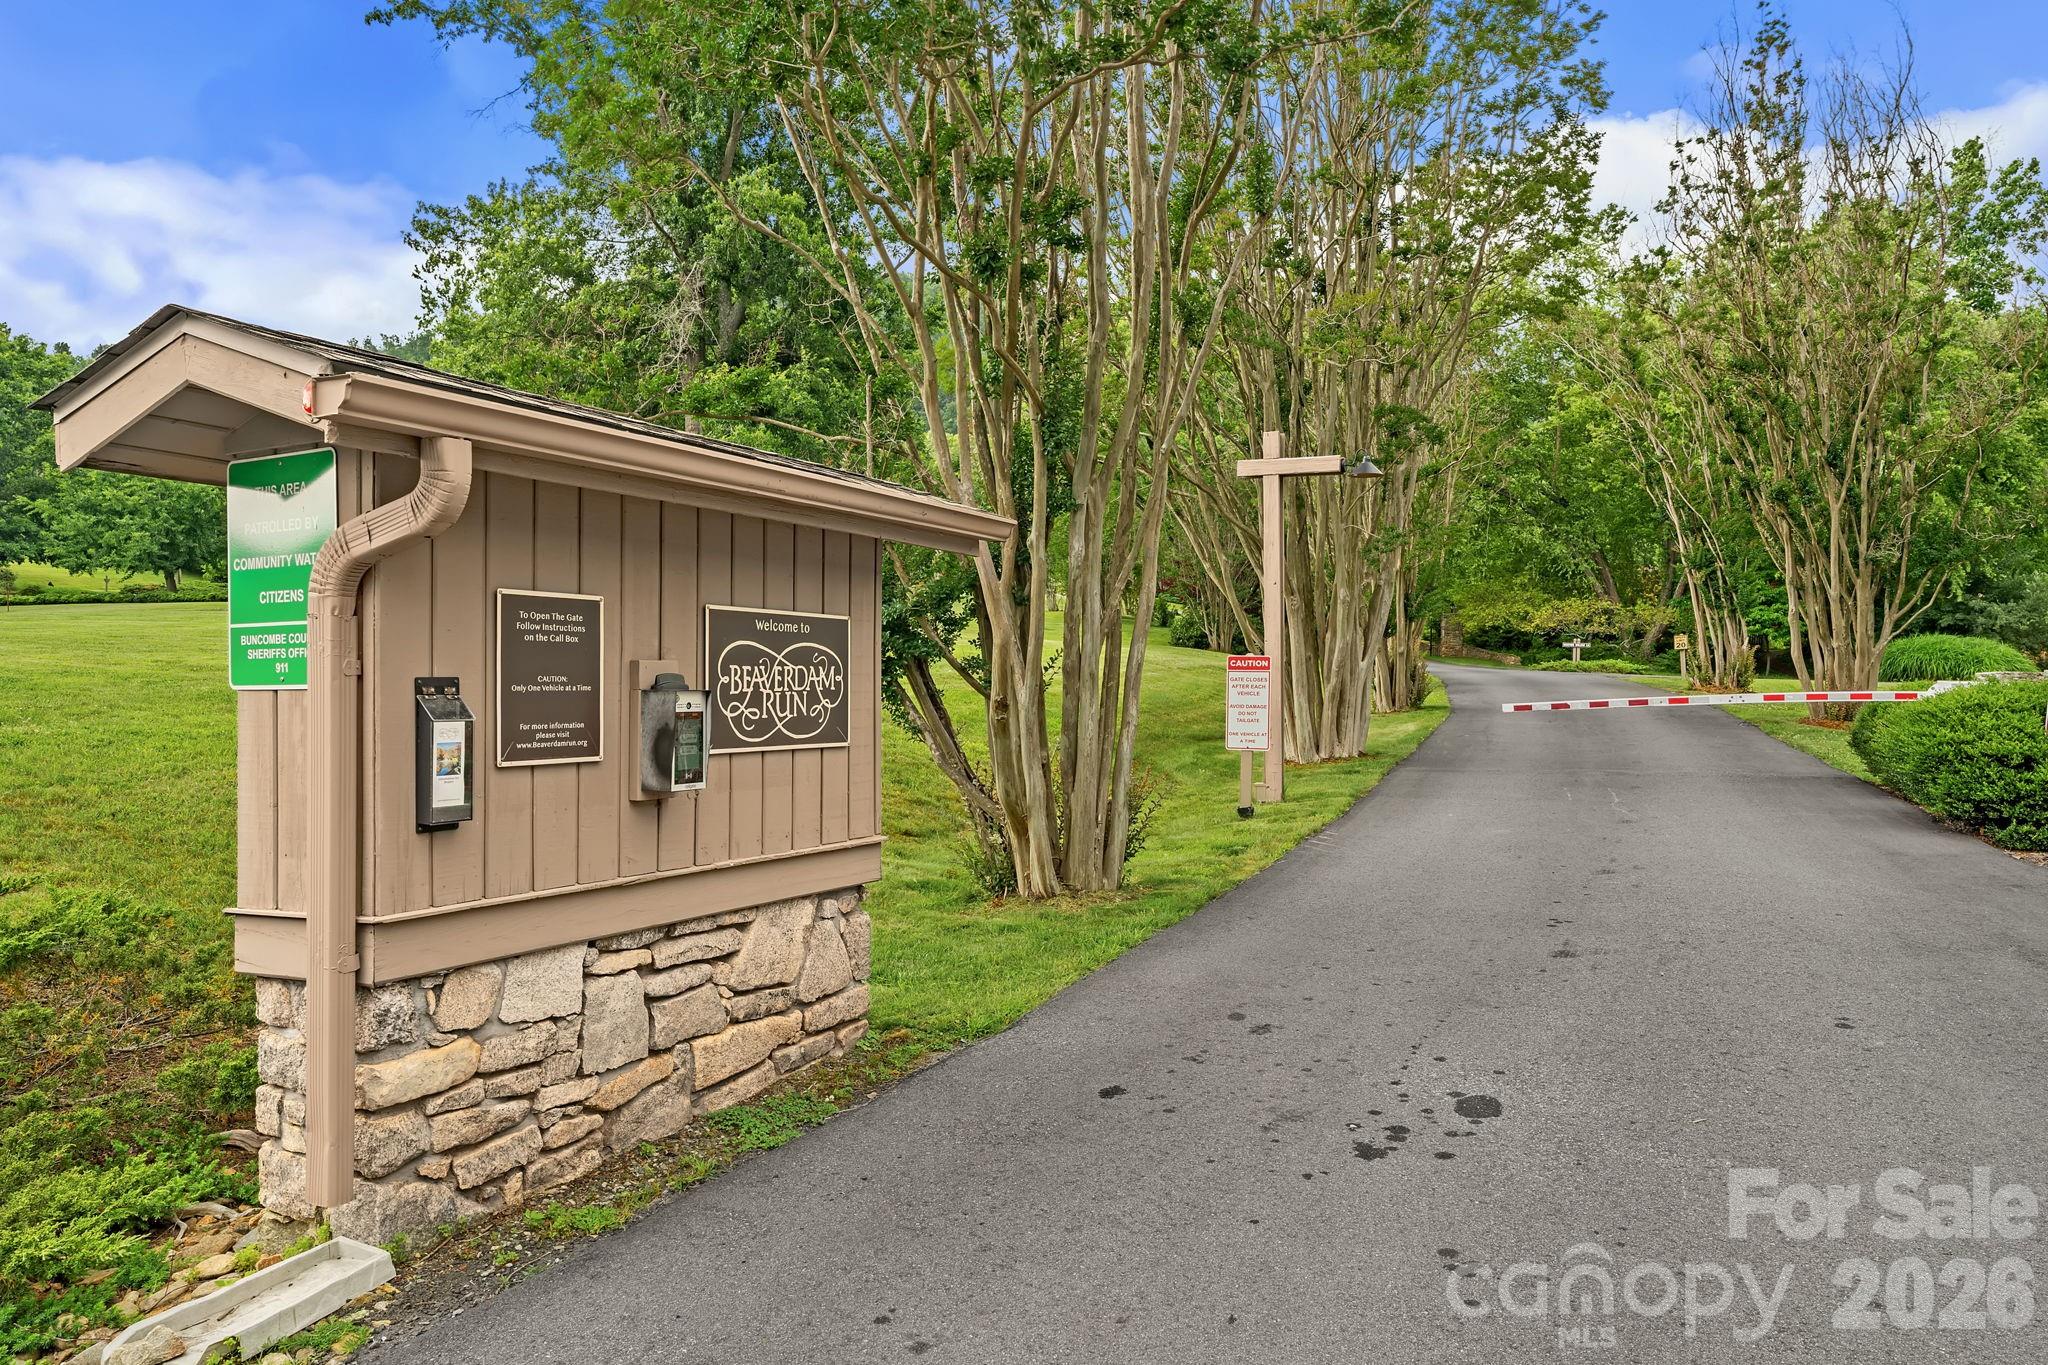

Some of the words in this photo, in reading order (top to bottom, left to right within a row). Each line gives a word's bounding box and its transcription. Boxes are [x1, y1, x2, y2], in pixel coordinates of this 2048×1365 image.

[280, 481, 307, 496] AREA
[244, 518, 302, 536] PATROLLED
[304, 515, 319, 530] BY
[233, 554, 292, 571] COMMUNITY
[294, 552, 316, 567] WAT
[259, 589, 304, 604] CITIZENS
[519, 610, 529, 619] To
[530, 611, 550, 621] Open
[551, 612, 565, 621] The
[566, 613, 584, 622] Gate
[516, 621, 541, 630] Follow
[542, 623, 586, 633] Instructions
[755, 618, 798, 633] Welcome
[800, 622, 811, 634] to
[240, 633, 287, 646] BUNCOMBE
[288, 633, 307, 644] COU
[535, 633, 549, 642] the
[549, 634, 564, 642] Call
[565, 634, 579, 643] Box
[247, 648, 287, 660] SHERIFFS
[288, 647, 307, 659] OFFI
[275, 662, 289, 673] 911
[537, 675, 568, 683] CAUTION:
[729, 663, 835, 695] BEAVERDAM
[511, 684, 527, 693] Only
[527, 684, 541, 692] One
[541, 684, 565, 692] Vehicle
[576, 684, 592, 692] Time
[761, 689, 808, 719] RUN
[519, 723, 531, 731] For
[549, 721, 585, 730] information
[535, 731, 556, 740] please
[516, 740, 588, 749] www.Beaverdamrun.org
